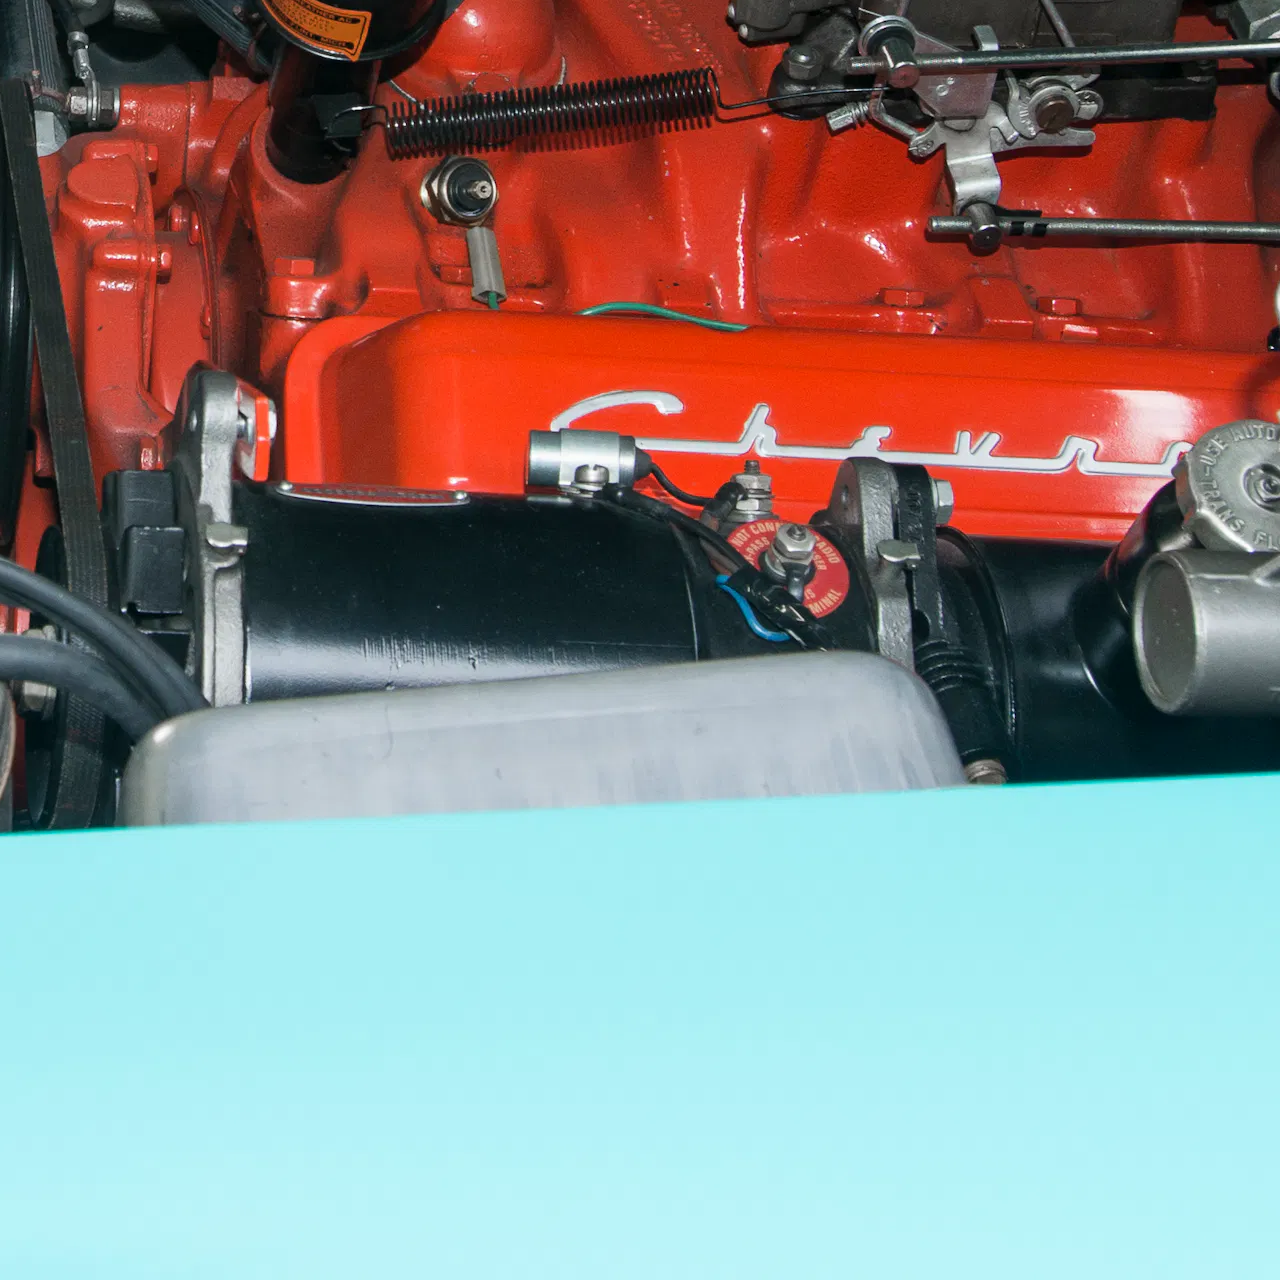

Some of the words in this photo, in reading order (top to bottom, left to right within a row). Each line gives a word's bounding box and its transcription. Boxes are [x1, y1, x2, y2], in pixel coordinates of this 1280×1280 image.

[1200, 434, 1229, 466] USE
[1200, 480, 1246, 532] TRANS
[732, 528, 752, 547] NOT
[808, 588, 842, 615] MINAL
